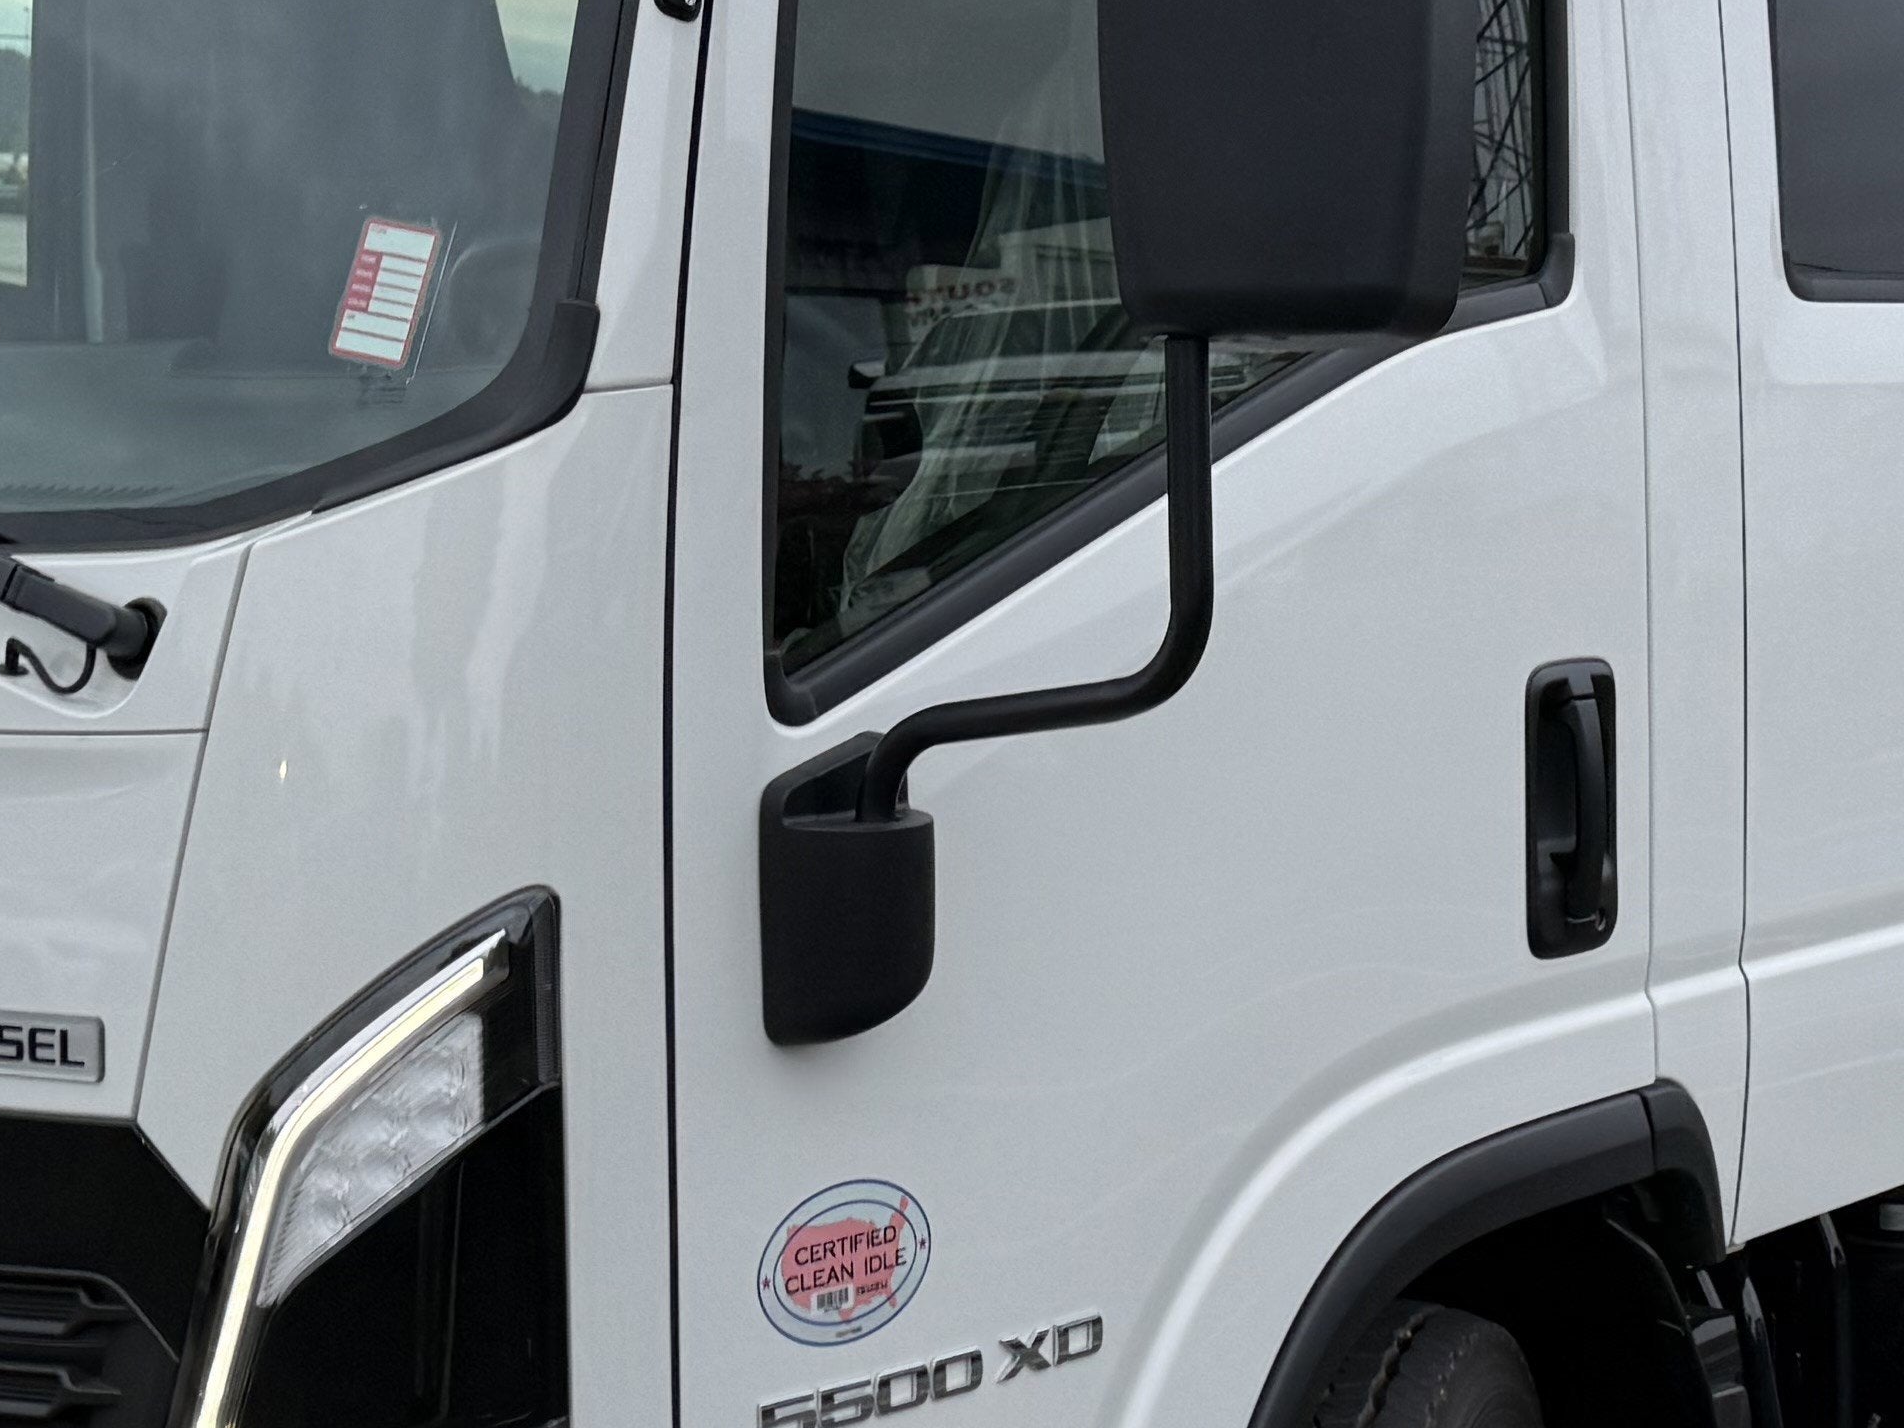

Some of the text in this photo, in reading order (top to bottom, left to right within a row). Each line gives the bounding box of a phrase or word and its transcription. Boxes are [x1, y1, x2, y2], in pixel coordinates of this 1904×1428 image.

[794, 1224, 897, 1267] CERTIFIED
[784, 1262, 855, 1297] CLEAN
[864, 1247, 908, 1278] IDLE
[994, 1307, 1104, 1386] XD
